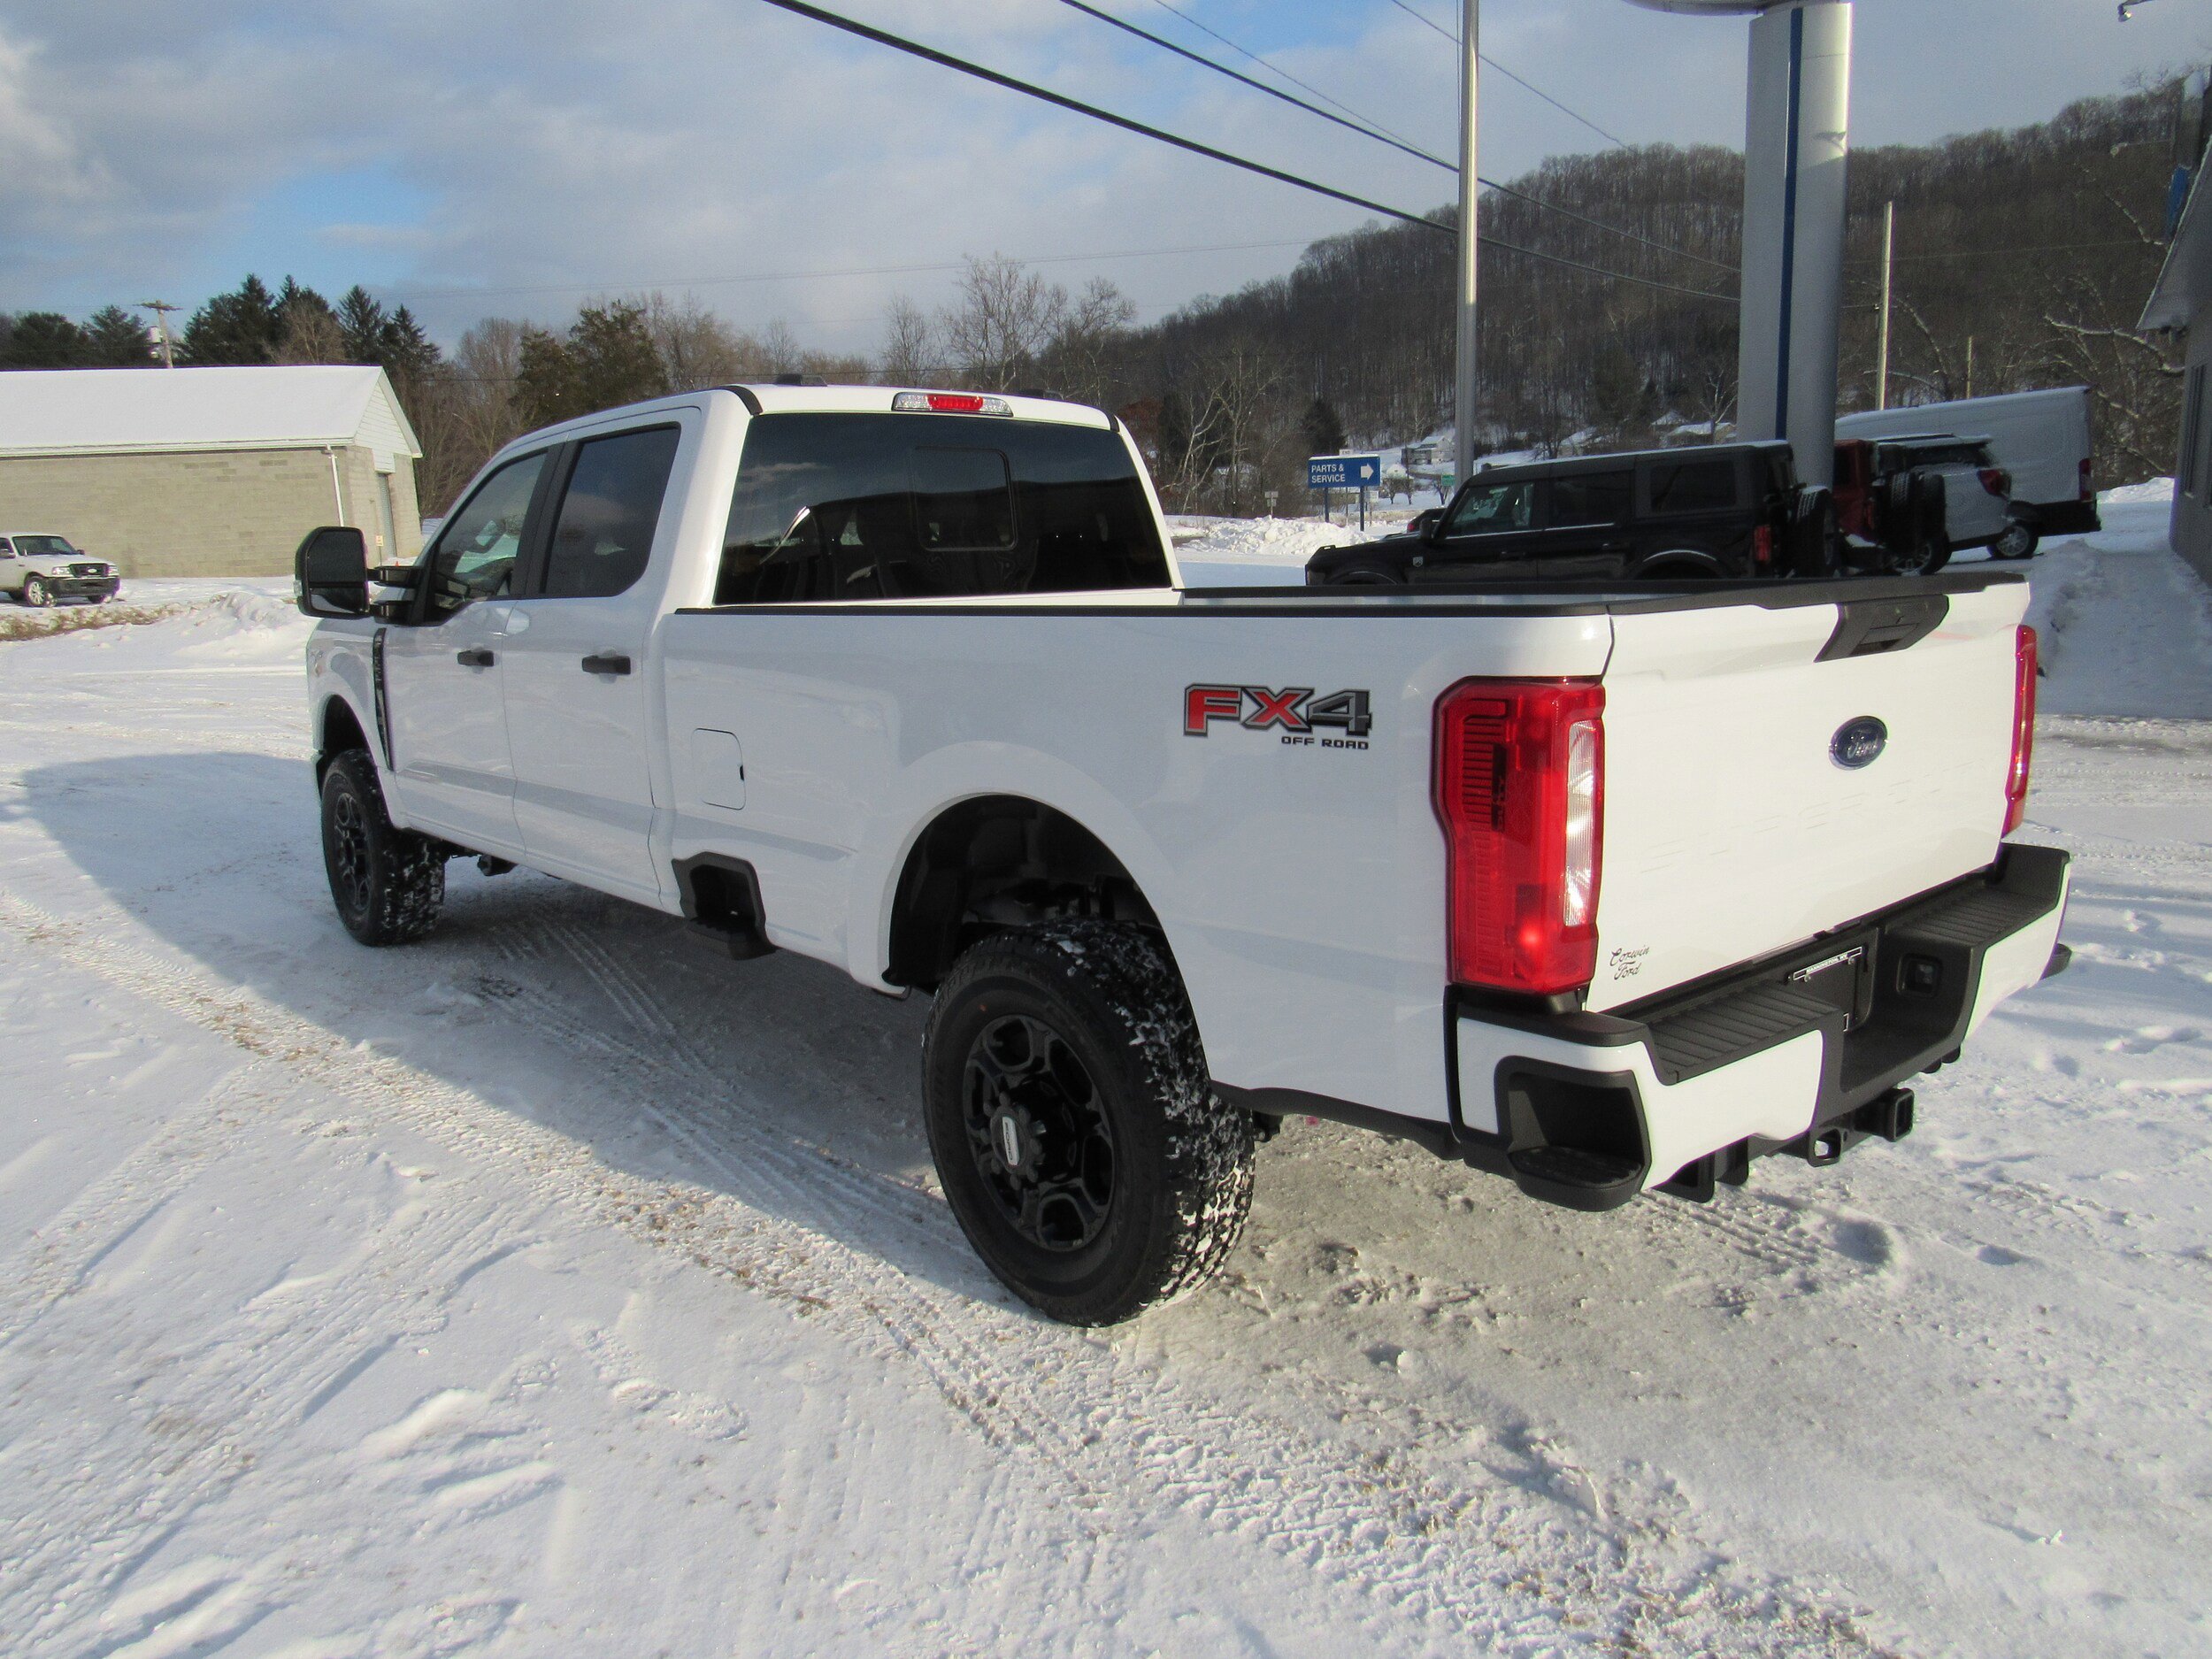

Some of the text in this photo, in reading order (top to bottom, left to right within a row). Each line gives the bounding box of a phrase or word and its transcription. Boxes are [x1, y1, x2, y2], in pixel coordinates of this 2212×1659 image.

[1311, 464, 1337, 473] PARTS
[1311, 474, 1346, 483] SERVICE
[1184, 683, 1372, 737] FX4
[1281, 736, 1369, 750] OFF ROAD
[1614, 961, 1642, 980] Ford
